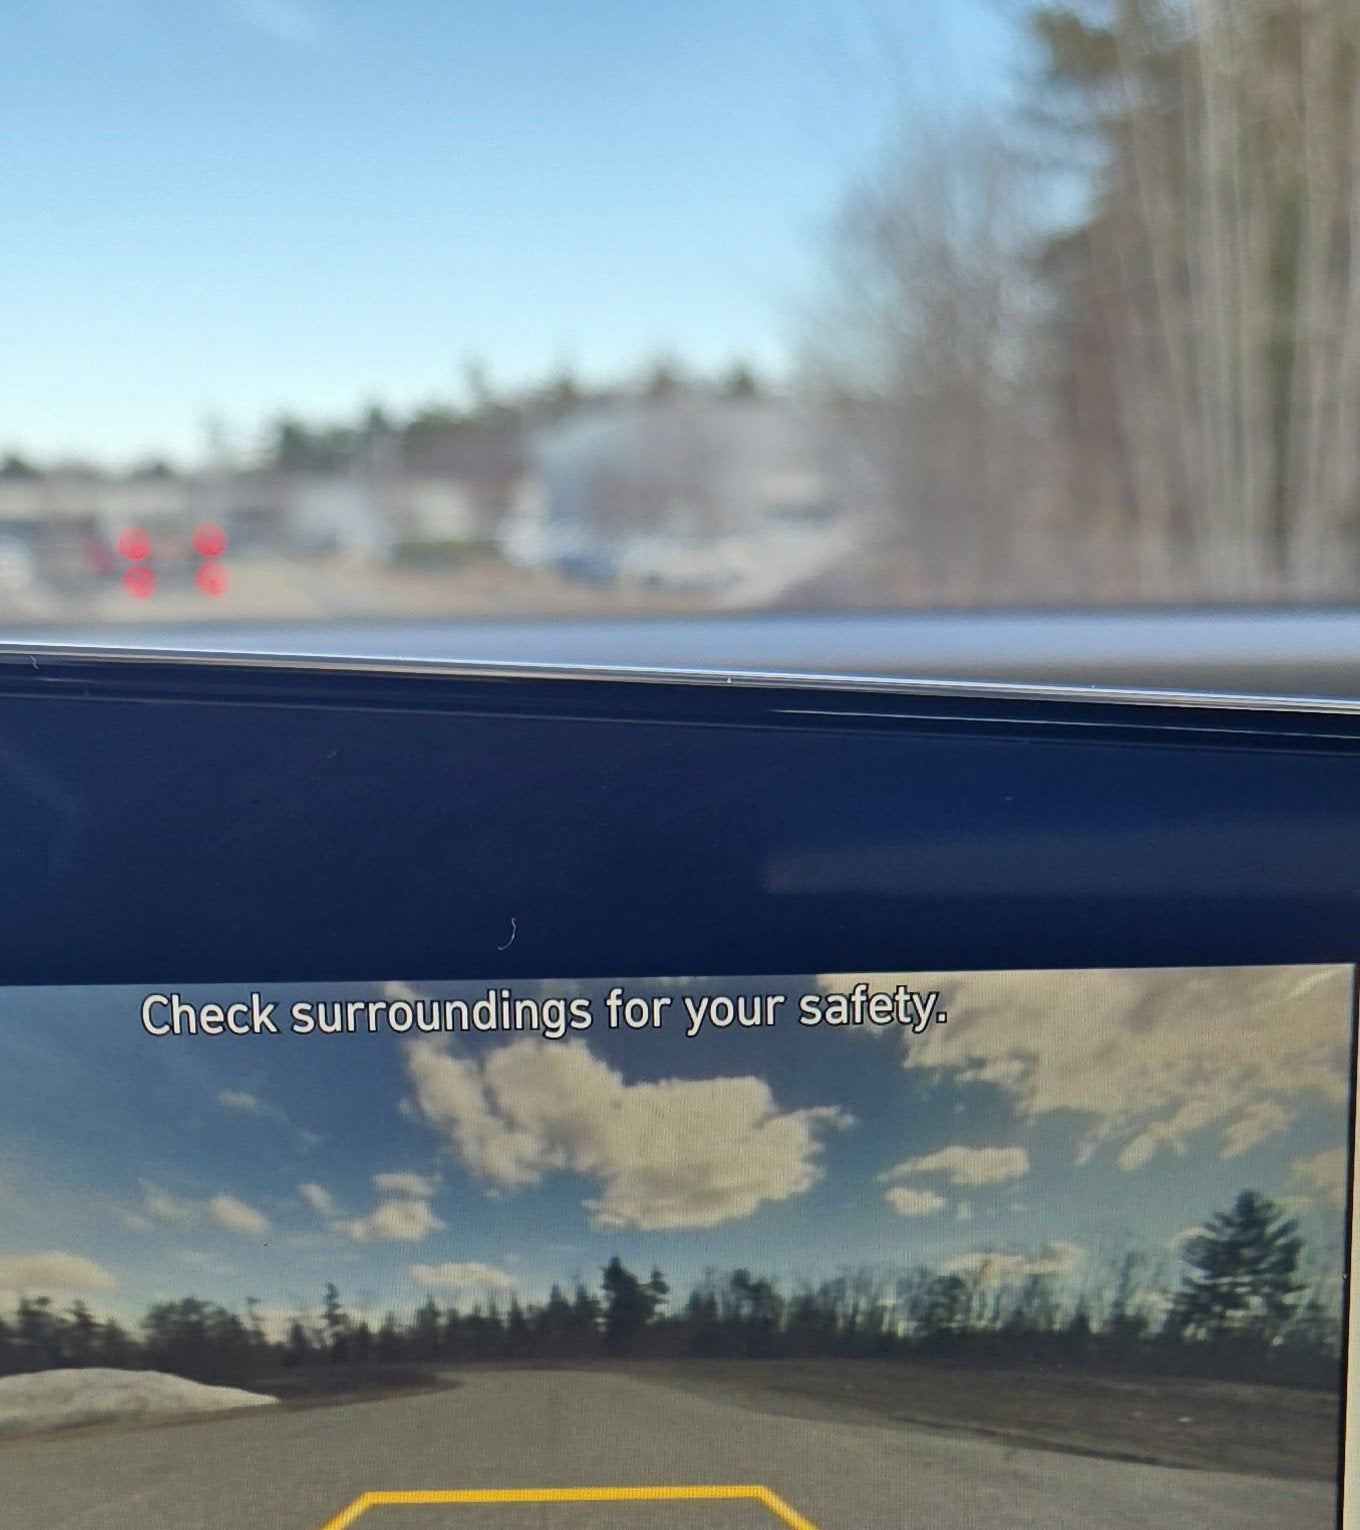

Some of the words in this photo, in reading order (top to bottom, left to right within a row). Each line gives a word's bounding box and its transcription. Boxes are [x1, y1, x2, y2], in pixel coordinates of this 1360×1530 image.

[140, 993, 279, 1036] Check
[291, 989, 593, 1039] surroundings
[606, 990, 671, 1030] for
[685, 991, 786, 1036] your
[798, 984, 949, 1030] safety.
